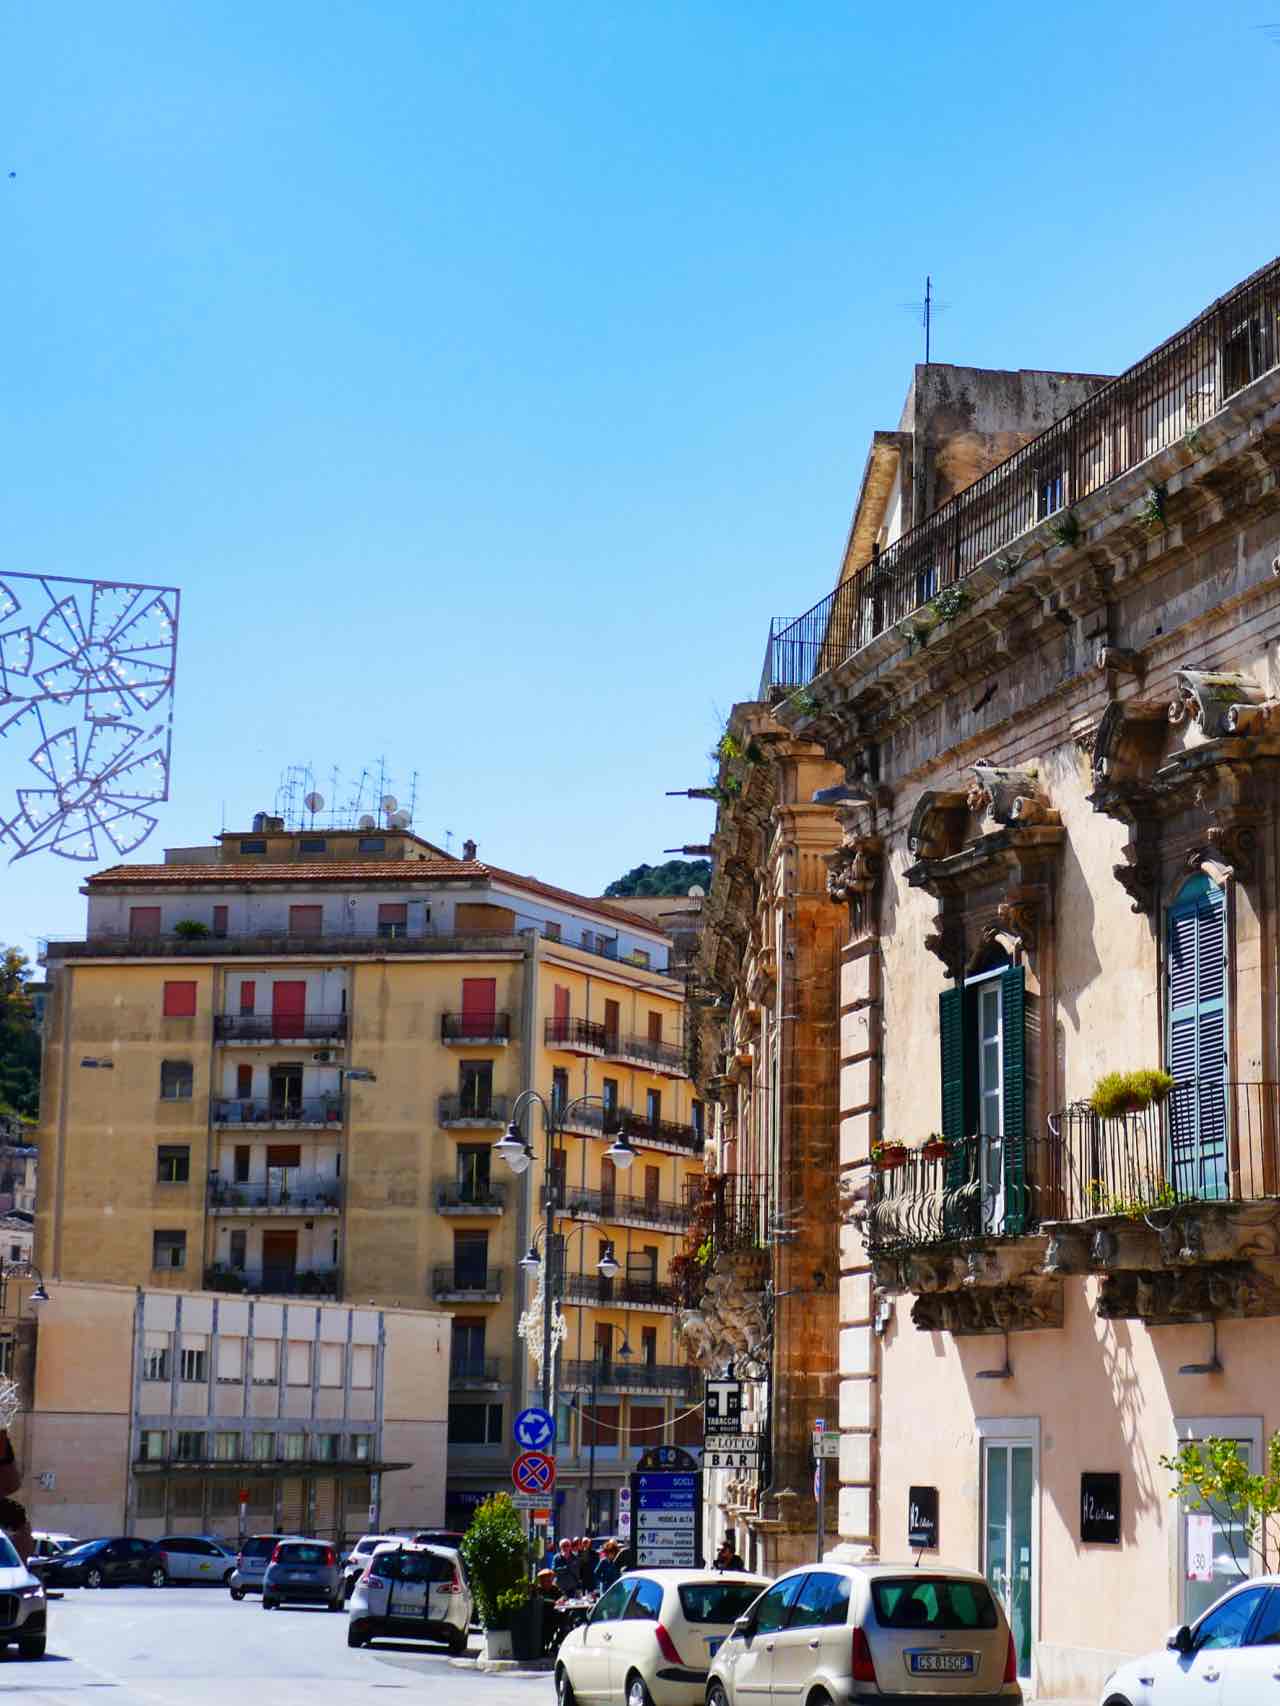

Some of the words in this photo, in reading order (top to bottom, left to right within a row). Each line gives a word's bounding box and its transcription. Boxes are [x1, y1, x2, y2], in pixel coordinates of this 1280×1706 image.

[707, 1383, 739, 1416] T
[707, 1417, 739, 1425] TABACCHI
[718, 1438, 755, 1449] LOTTO
[711, 1454, 748, 1466] BAR
